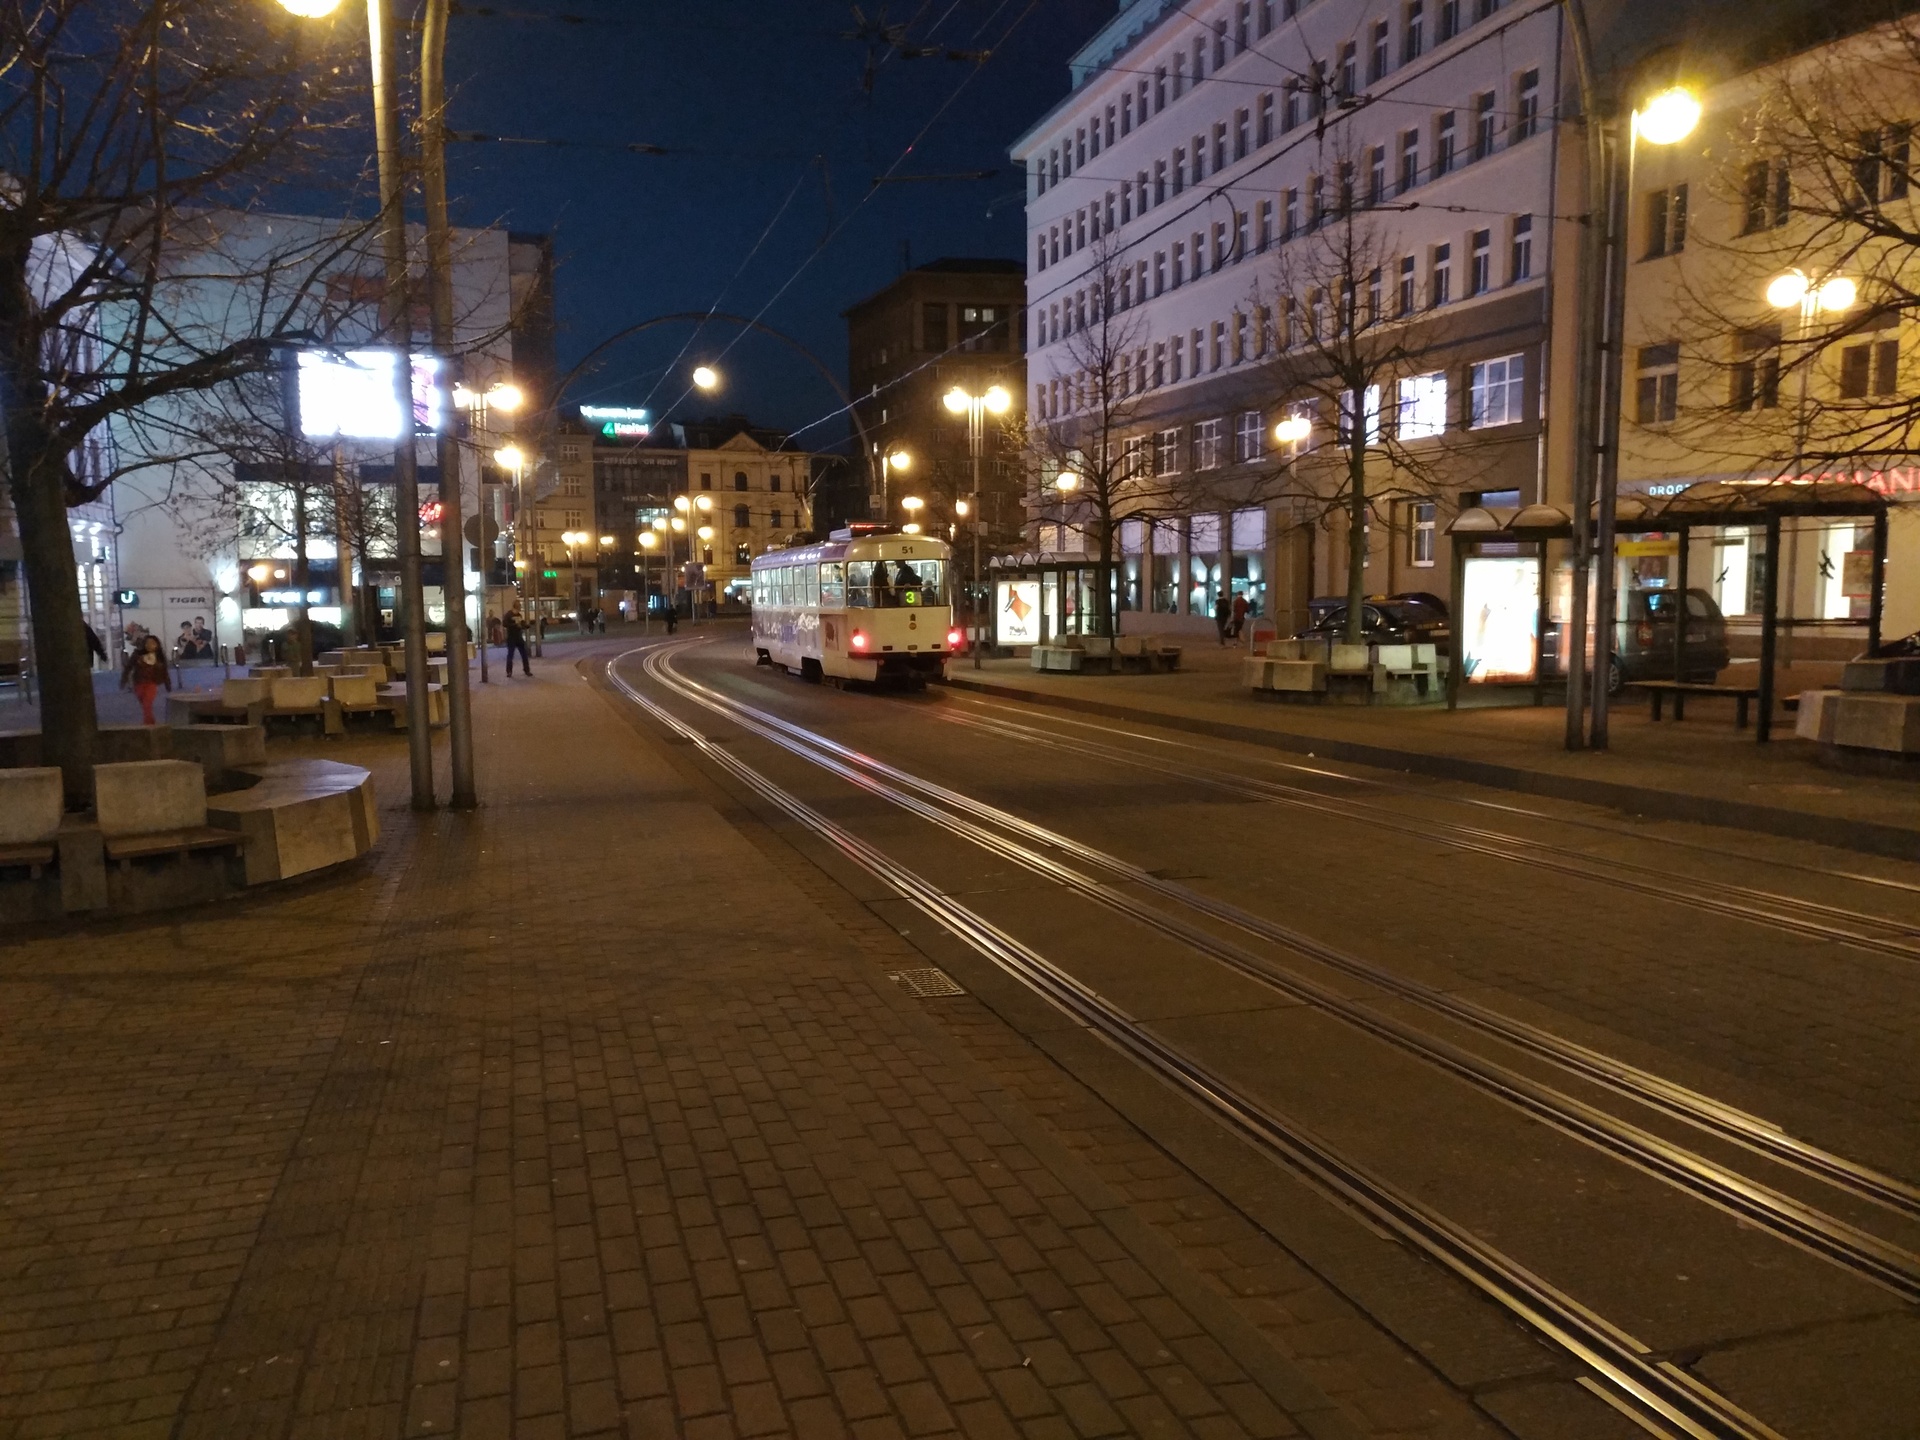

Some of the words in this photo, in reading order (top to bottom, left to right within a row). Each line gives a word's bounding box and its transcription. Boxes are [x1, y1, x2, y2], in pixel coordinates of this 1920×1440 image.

[1649, 484, 1690, 496] DROG
[901, 546, 913, 554] 51
[905, 591, 915, 604] 3
